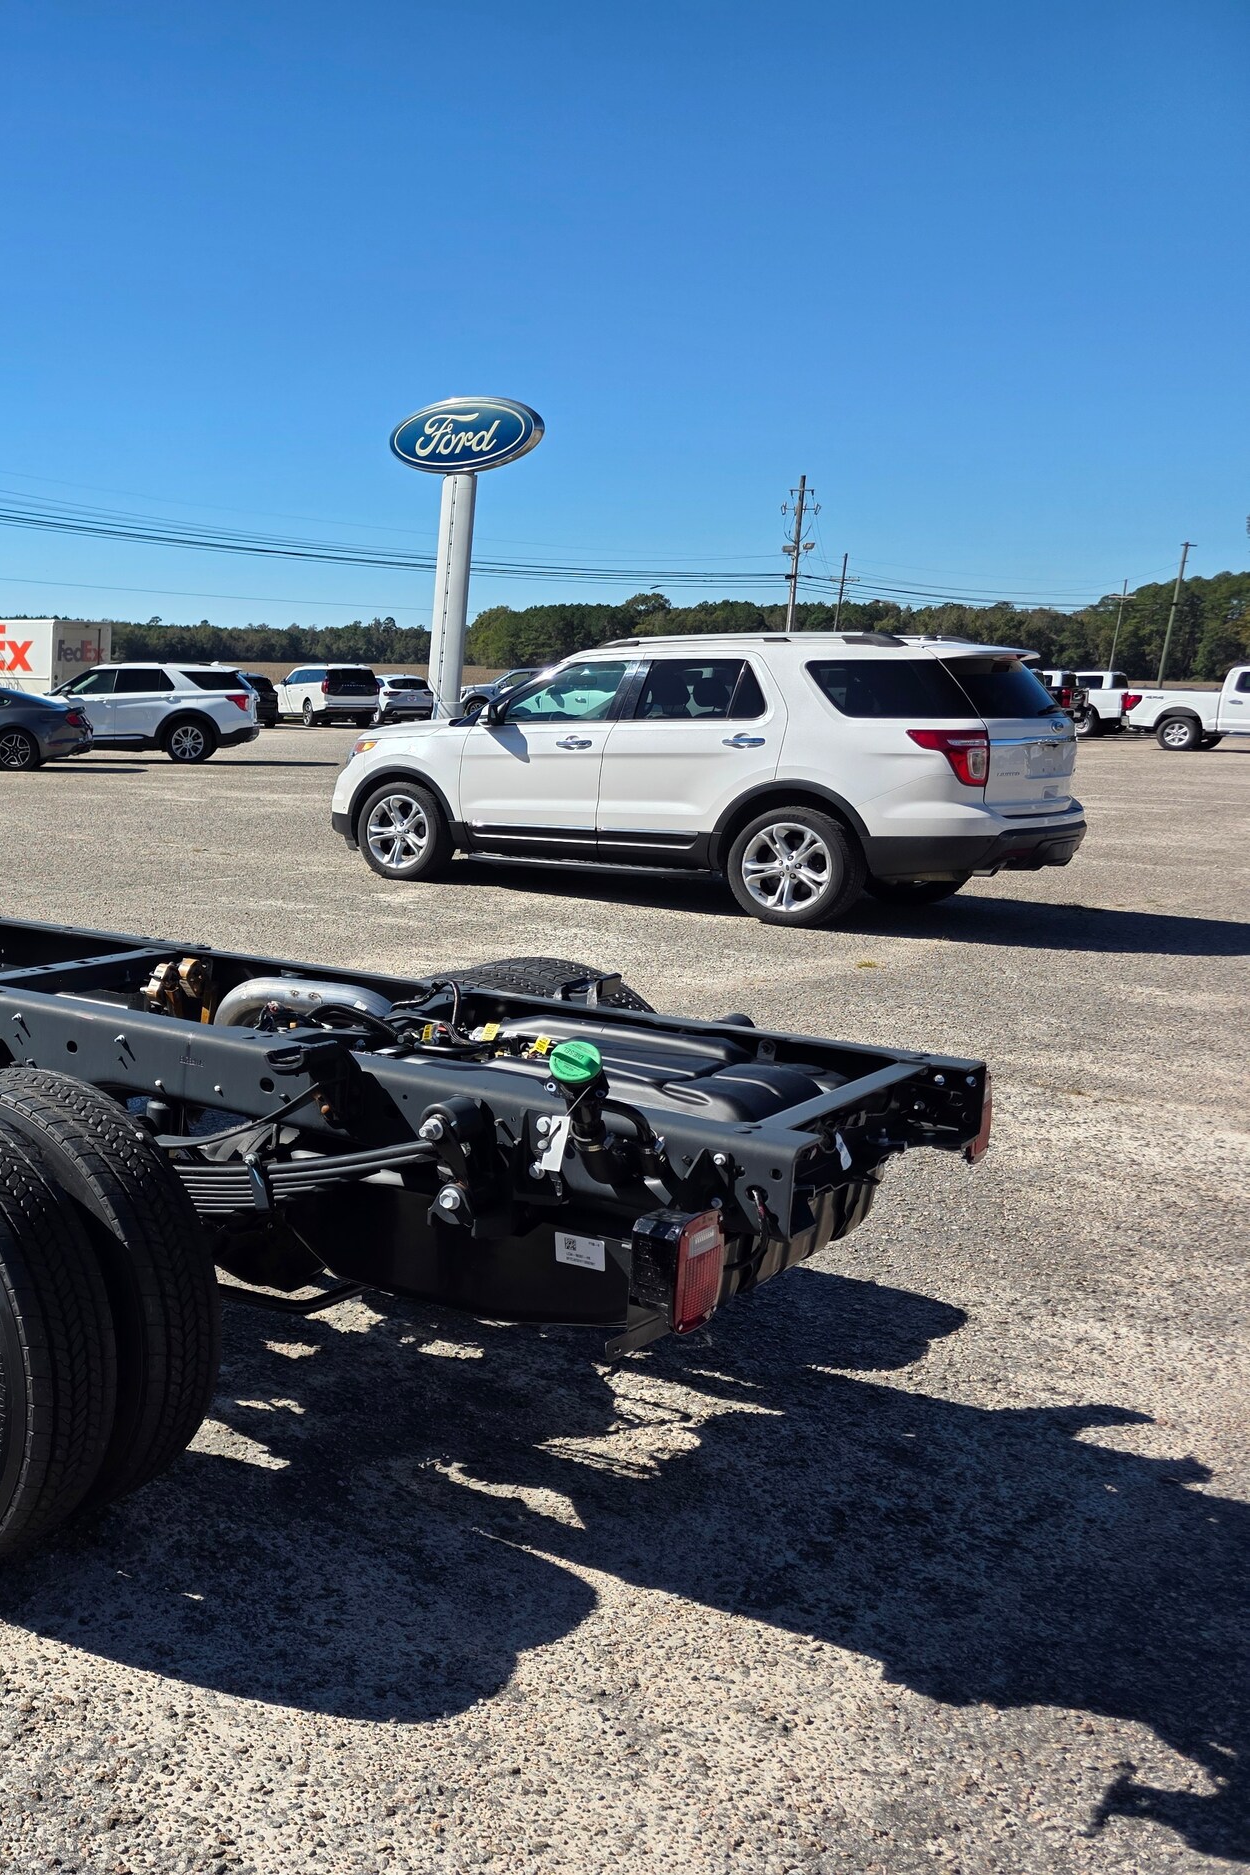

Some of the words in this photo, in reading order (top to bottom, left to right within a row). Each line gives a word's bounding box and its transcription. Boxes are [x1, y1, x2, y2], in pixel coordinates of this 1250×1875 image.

[415, 413, 501, 457] Ford
[58, 639, 105, 662] FedEx
[564, 1046, 585, 1060] DIESEL
